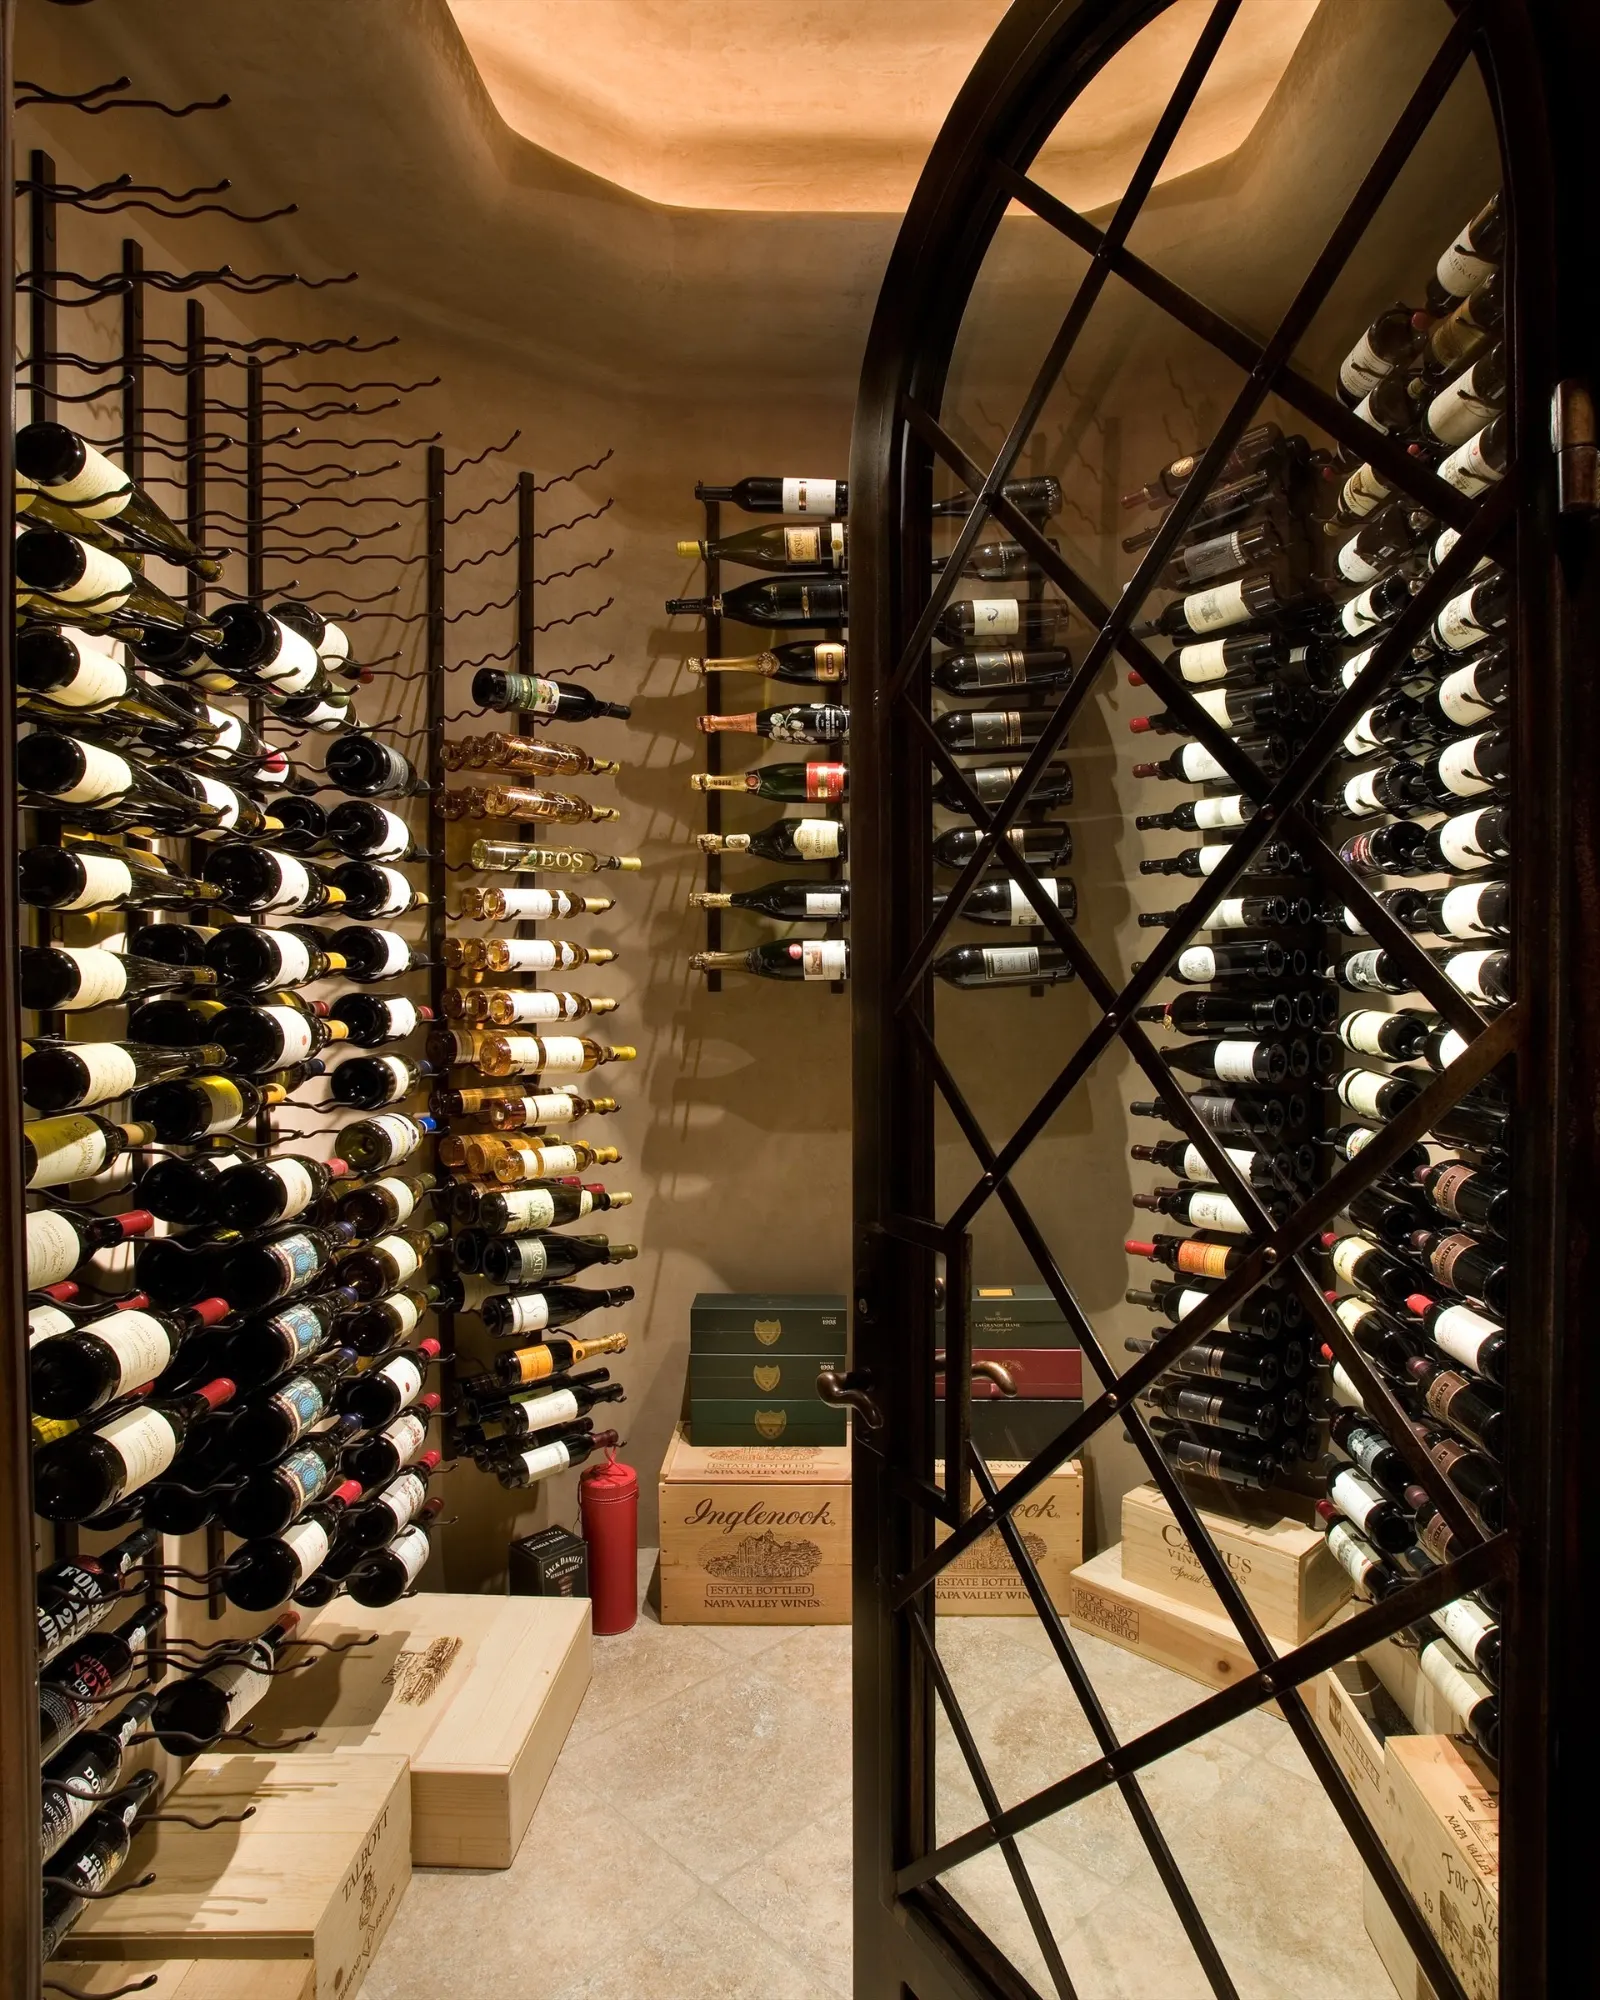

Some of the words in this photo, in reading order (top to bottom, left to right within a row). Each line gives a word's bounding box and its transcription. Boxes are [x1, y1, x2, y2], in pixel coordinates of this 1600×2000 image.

[541, 850, 584, 868] EOS
[531, 1239, 544, 1278] ERATH
[684, 1498, 831, 1535] Inglenook
[1162, 1524, 1252, 1574] CAUS
[545, 1561, 560, 1578] JACK
[560, 1555, 584, 1565] DANIEL'S
[565, 1564, 580, 1574] BARREL
[1170, 1565, 1204, 1584] Special
[710, 1586, 753, 1595] ESTATE
[755, 1586, 811, 1595] BOTTLED
[937, 1578, 978, 1586] ESTATE
[962, 1591, 1003, 1599] VALLEY
[1005, 1591, 1031, 1599] WIN
[704, 1599, 735, 1608] NAPA
[737, 1599, 778, 1608] VALLEY
[780, 1599, 821, 1608] WINES
[1077, 1588, 1104, 1607] RIDGE
[1113, 1604, 1133, 1619] 1997
[1077, 1600, 1130, 1628] CALIFORNIA
[1077, 1609, 1109, 1631] MONTE
[1111, 1623, 1138, 1641] BELLO
[342, 1805, 389, 1902] TALBOTT
[1445, 1814, 1468, 1840] NAPA
[1466, 1843, 1493, 1877] VALLEY
[1442, 1852, 1468, 1895] Far
[375, 1883, 396, 1929] ESTATE
[1423, 1891, 1434, 1914] 19
